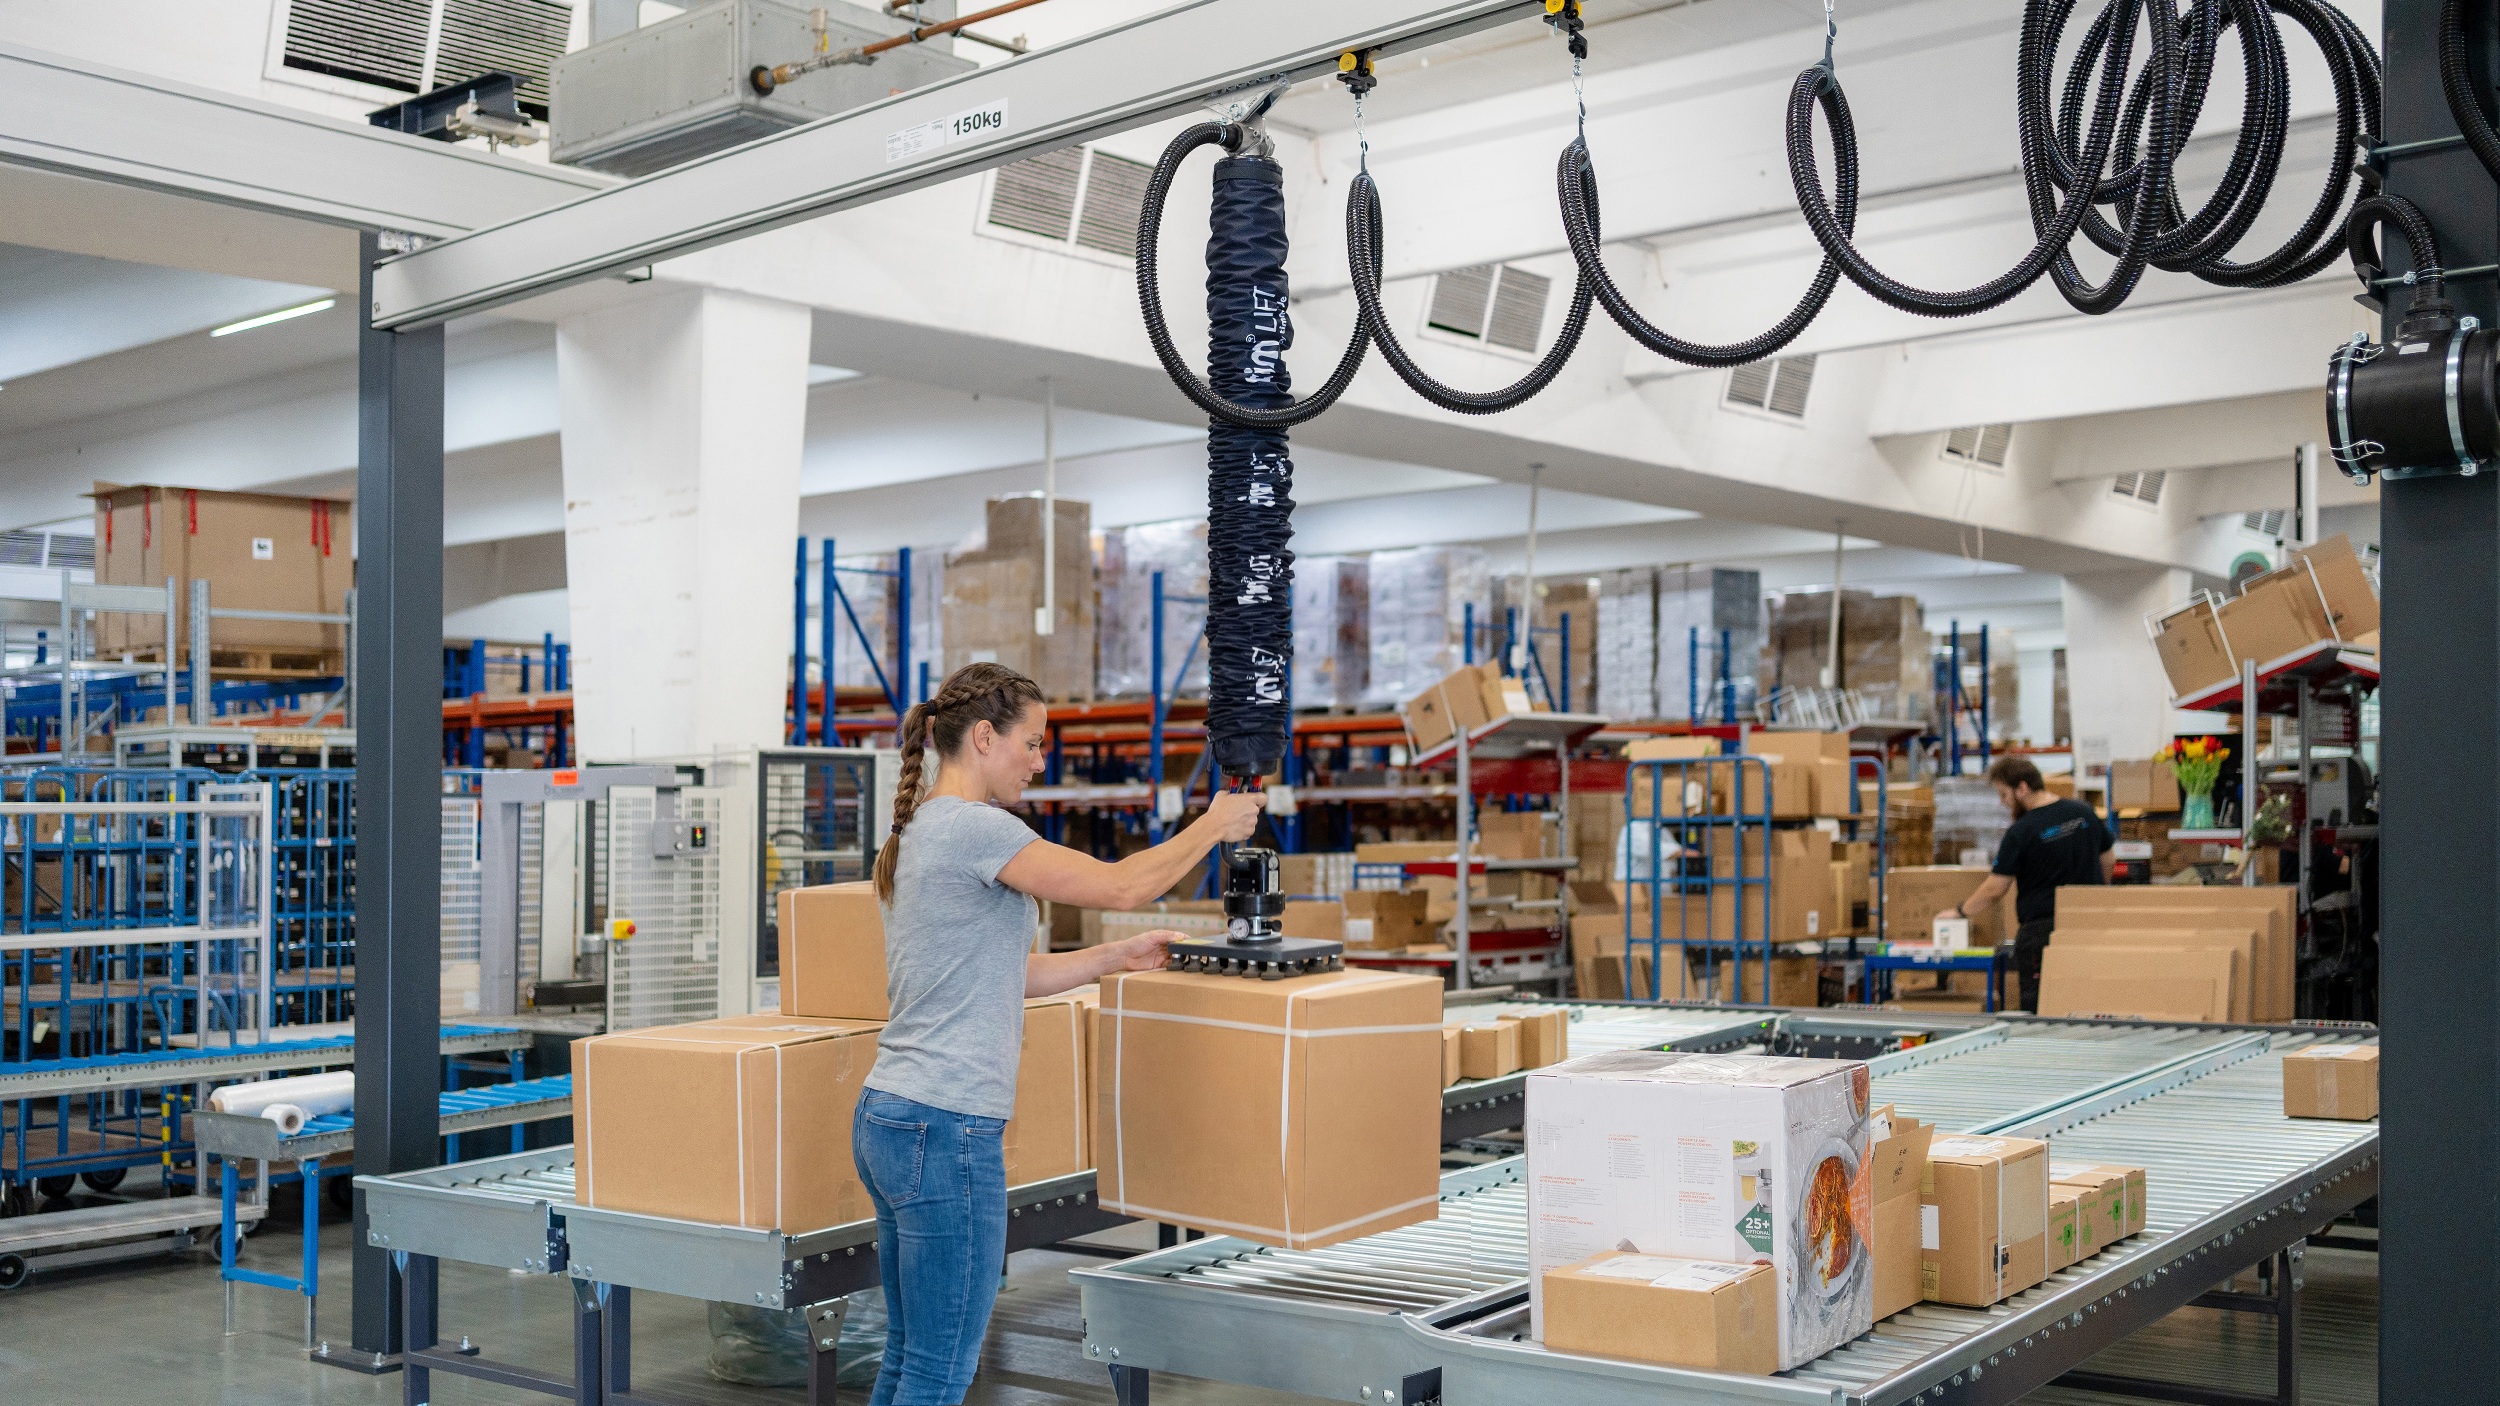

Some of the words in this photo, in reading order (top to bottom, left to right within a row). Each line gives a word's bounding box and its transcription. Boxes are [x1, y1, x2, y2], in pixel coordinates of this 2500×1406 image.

[953, 109, 1002, 136] 150kg
[1253, 285, 1279, 333] LIFT
[1745, 1217, 1770, 1230] 25+
